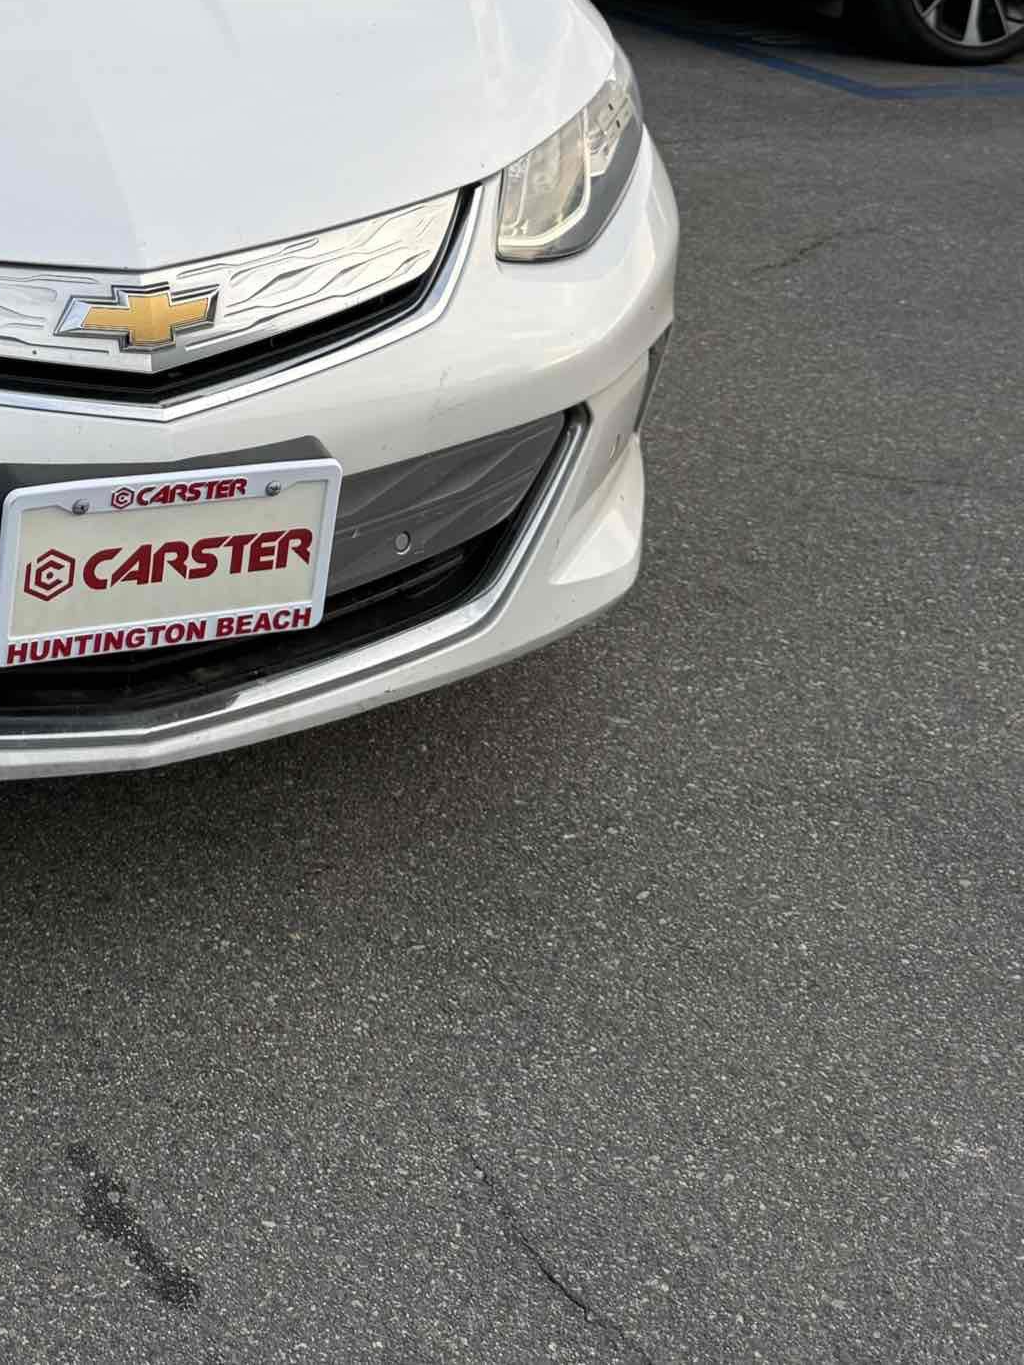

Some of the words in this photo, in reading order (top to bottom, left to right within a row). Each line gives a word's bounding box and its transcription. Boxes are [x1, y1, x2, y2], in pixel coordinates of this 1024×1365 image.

[136, 477, 248, 507] CARSTER
[82, 528, 313, 590] CARSTER
[5, 618, 208, 665] HUNTINGTON
[216, 607, 312, 637] BEACH
